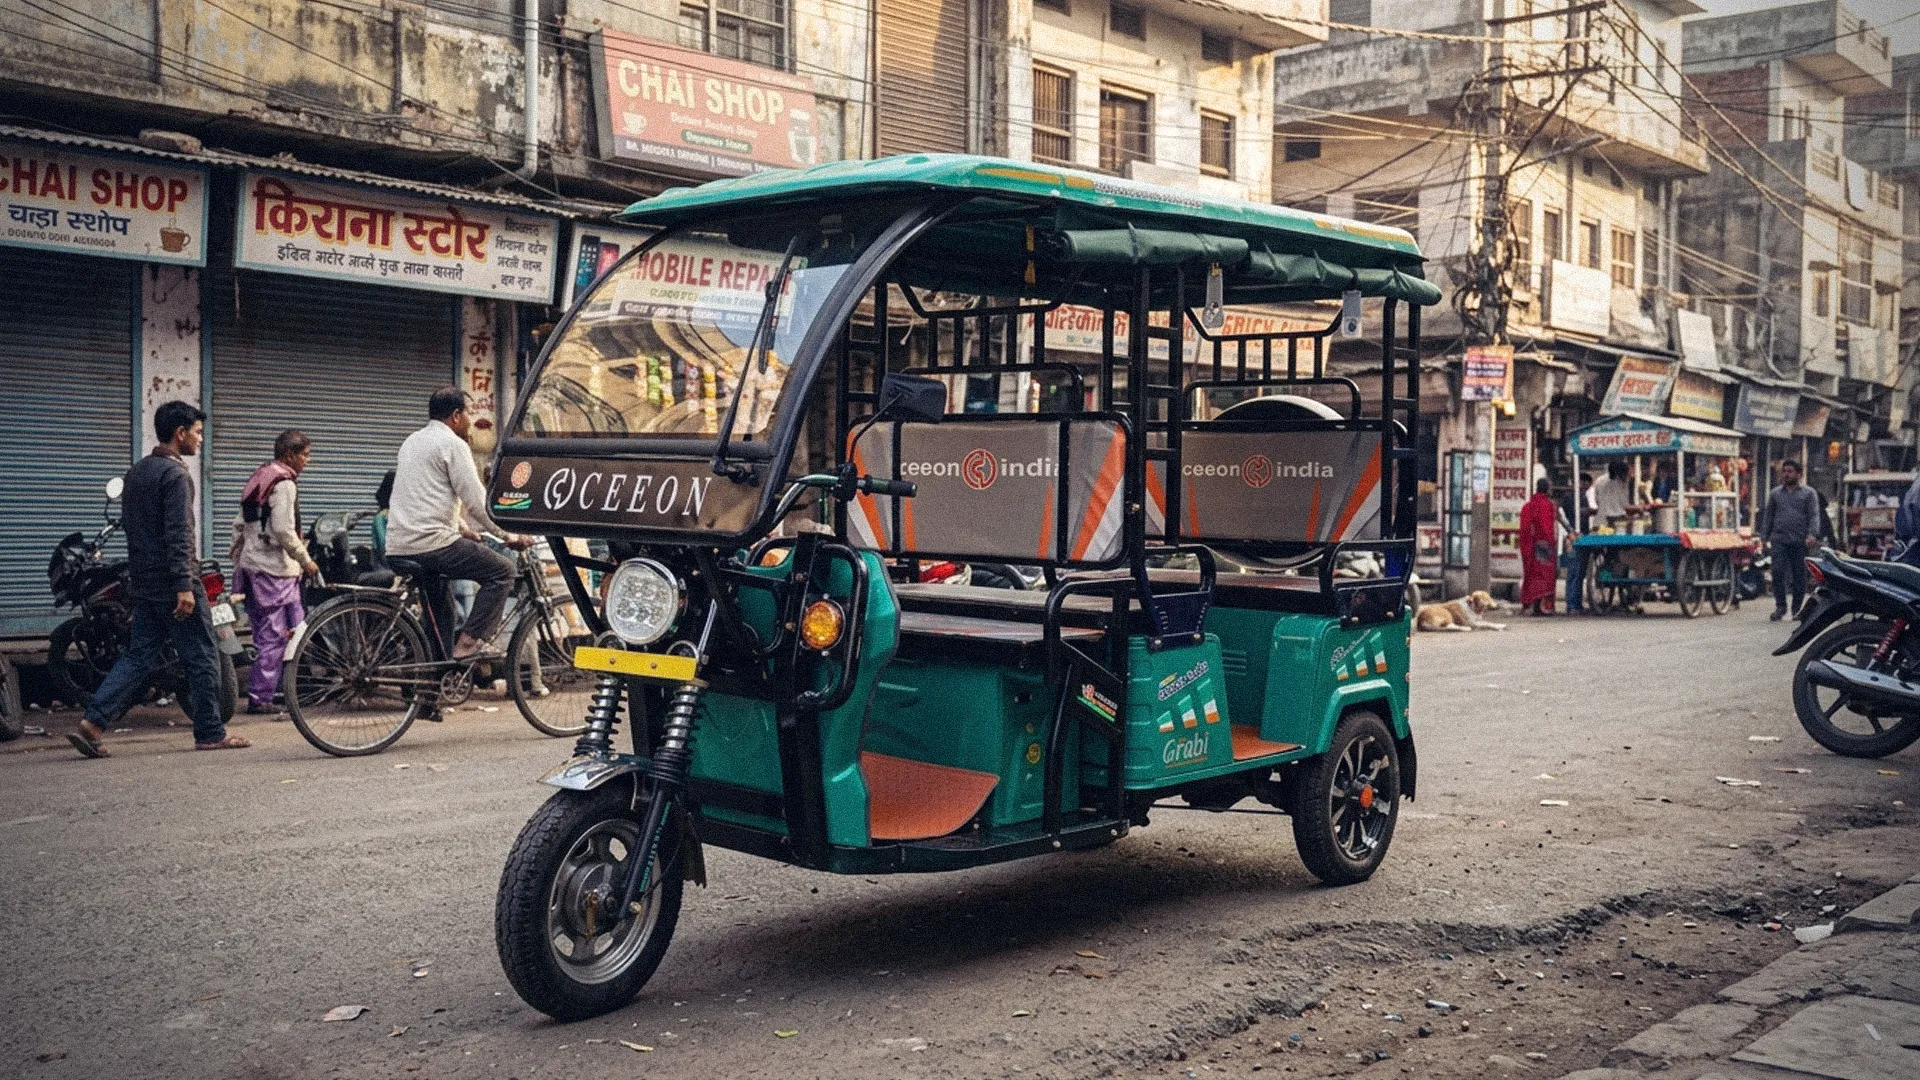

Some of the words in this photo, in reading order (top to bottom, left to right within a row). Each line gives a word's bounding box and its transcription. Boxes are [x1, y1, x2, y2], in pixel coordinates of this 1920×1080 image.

[618, 59, 695, 108] CHAI
[704, 78, 784, 125] SHOP
[90, 168, 188, 212] SHOP
[253, 177, 395, 246] किराना
[403, 204, 490, 259] स्टोर
[1182, 464, 1240, 477] ceeon
[1276, 462, 1334, 478] india
[579, 472, 712, 517] CEEON
